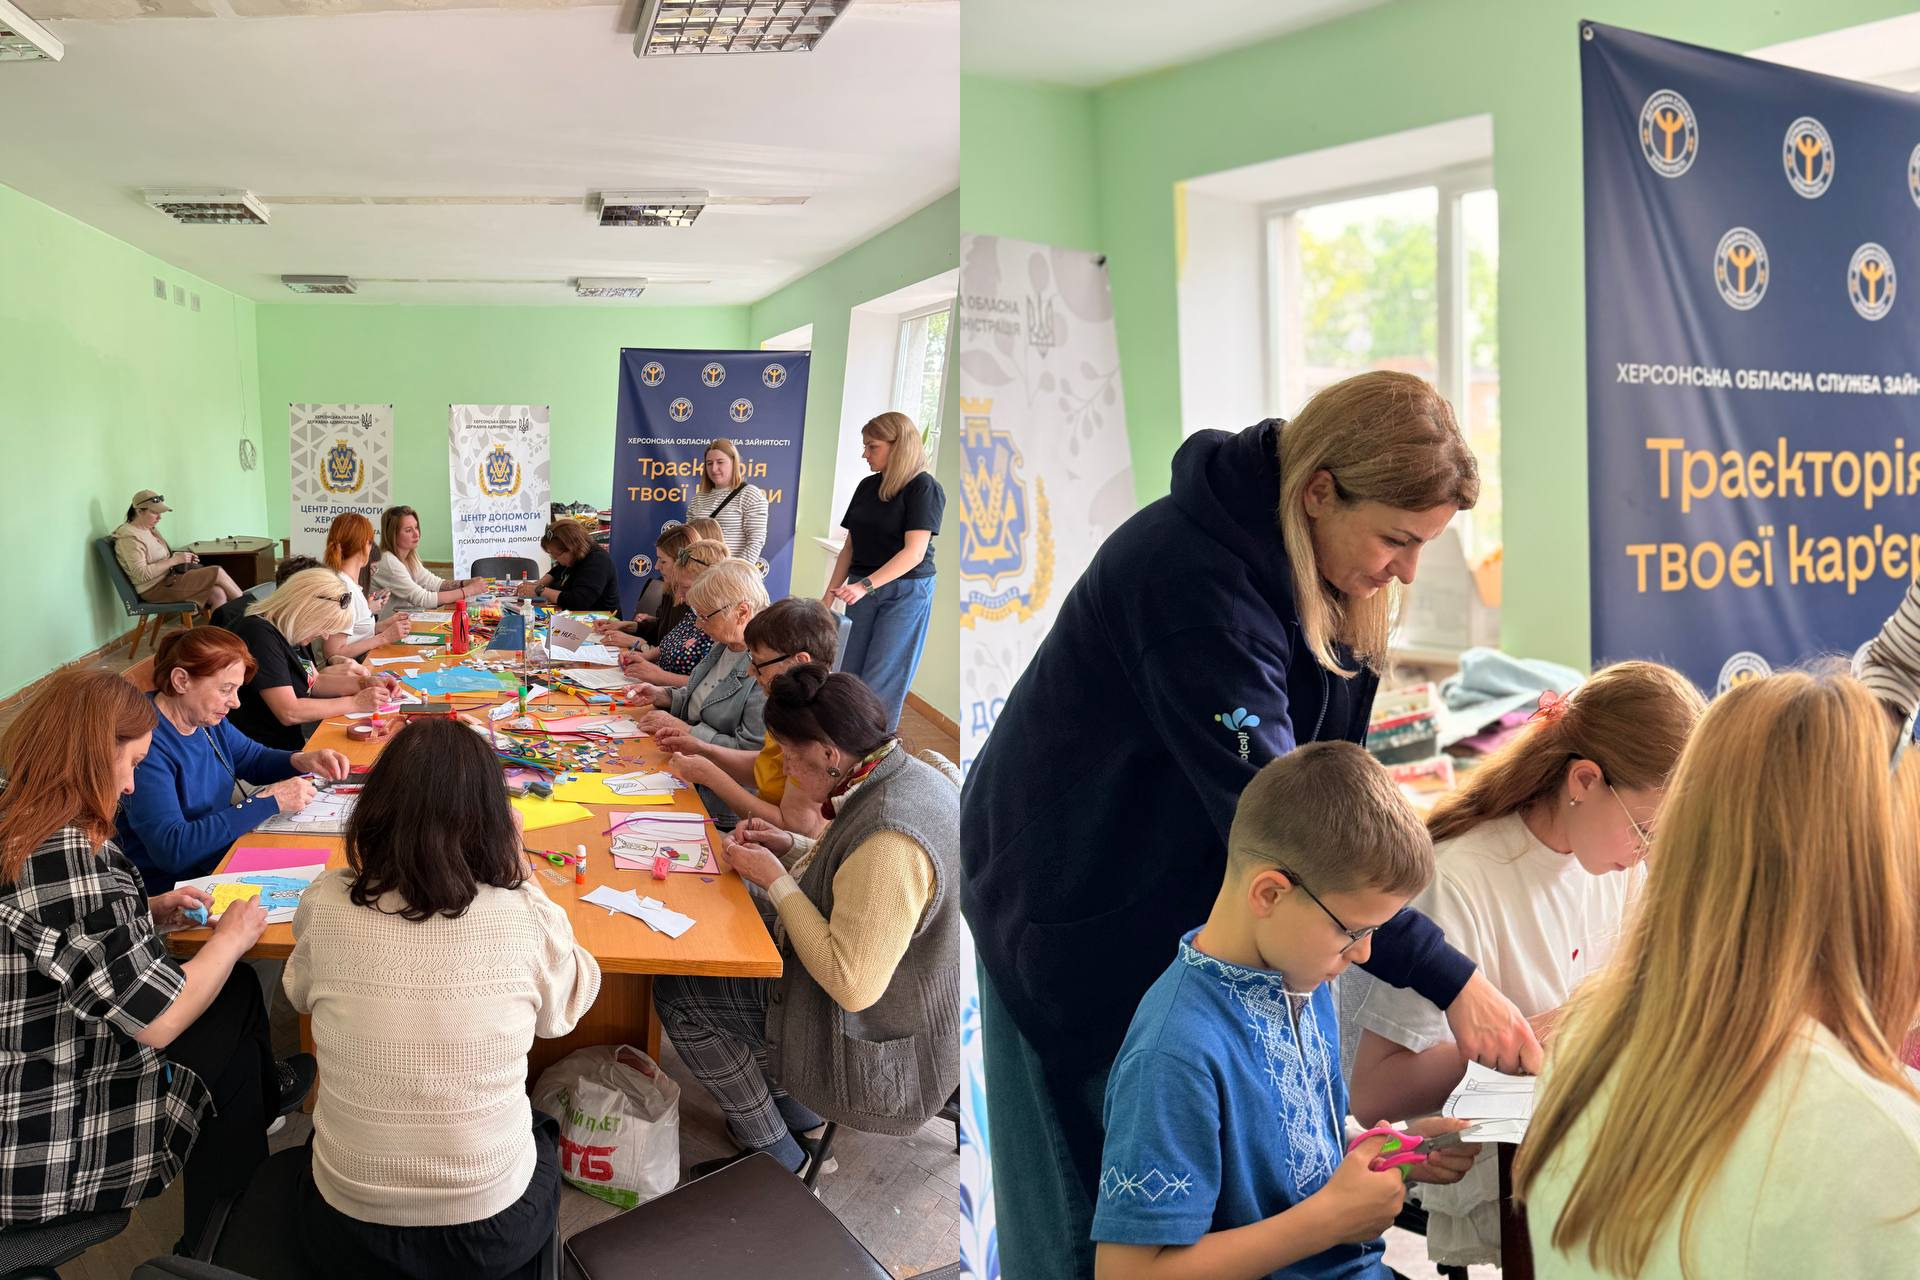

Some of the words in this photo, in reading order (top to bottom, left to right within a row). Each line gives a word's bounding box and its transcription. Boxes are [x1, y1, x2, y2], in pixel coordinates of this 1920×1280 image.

[1616, 362, 1733, 389] ХЕРСОНСЬКА
[1735, 370, 1814, 392] ОБЛАСНА
[1816, 373, 1882, 395] СЛУЖБА
[627, 437, 675, 445] ХЕРСОНСЬКА
[675, 438, 711, 446] ОБЛАСНА
[744, 438, 791, 447] ЗАЙНЯТОСТІ
[627, 483, 689, 503] твоєї
[300, 505, 329, 514] ЦЕНТР
[329, 505, 384, 515] ДОПОМОГИ
[460, 513, 488, 523] ЦЕНТР
[488, 512, 542, 522] ДОПОМОГИ
[474, 525, 528, 534] ХЕРСОНЦЯМ
[458, 536, 506, 545] ПСИХОЛОГІЧНА
[508, 536, 541, 544] ДОПОМОГ
[1625, 524, 1775, 594] твоєї
